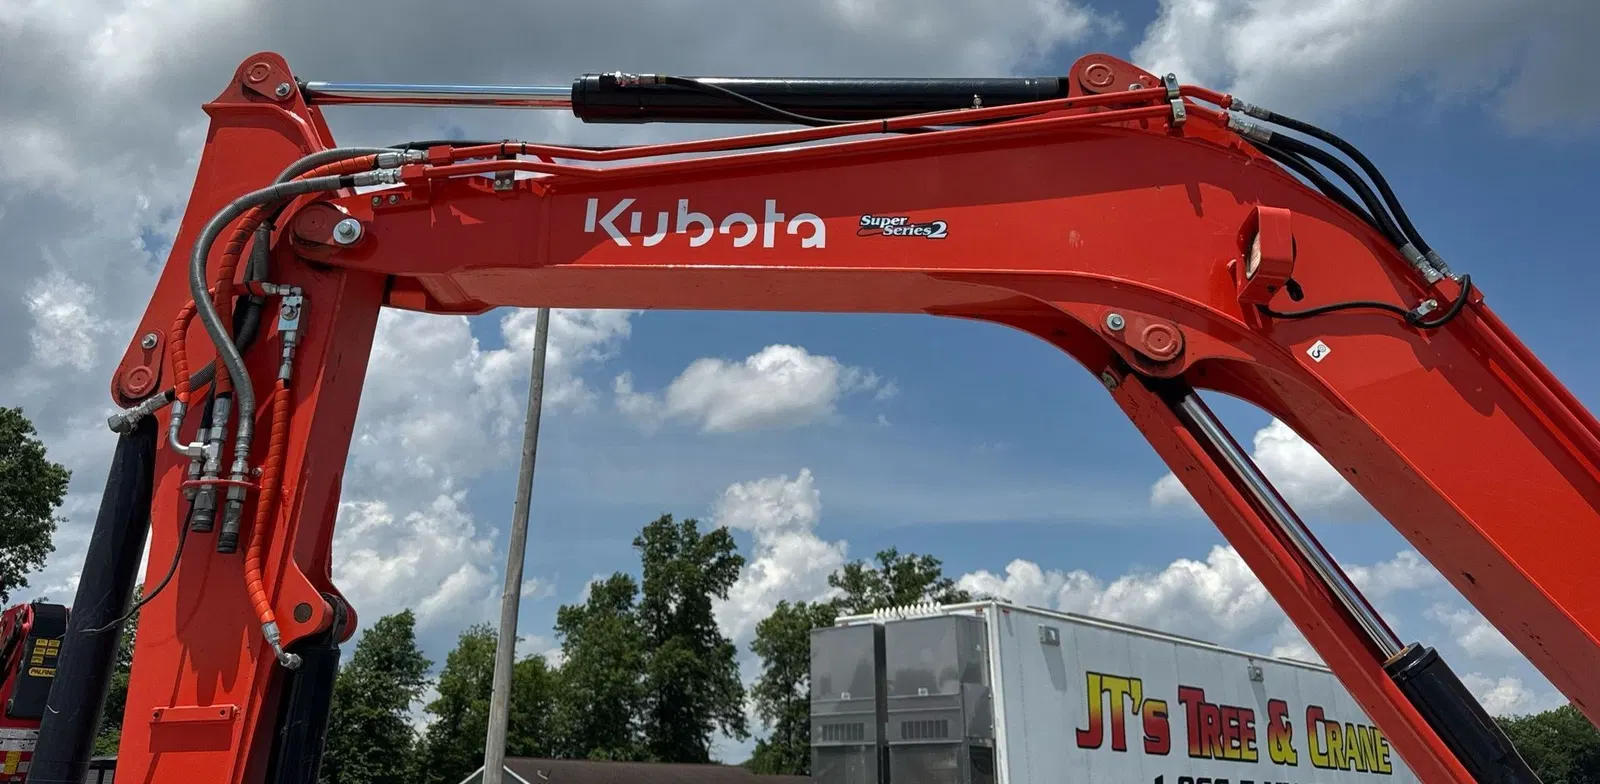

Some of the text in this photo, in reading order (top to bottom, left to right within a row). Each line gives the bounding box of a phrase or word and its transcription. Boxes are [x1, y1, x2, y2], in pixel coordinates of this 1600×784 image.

[585, 198, 826, 248] Kubota
[860, 215, 908, 228] Super
[1076, 671, 1392, 775] JT's TREE & CRANE
